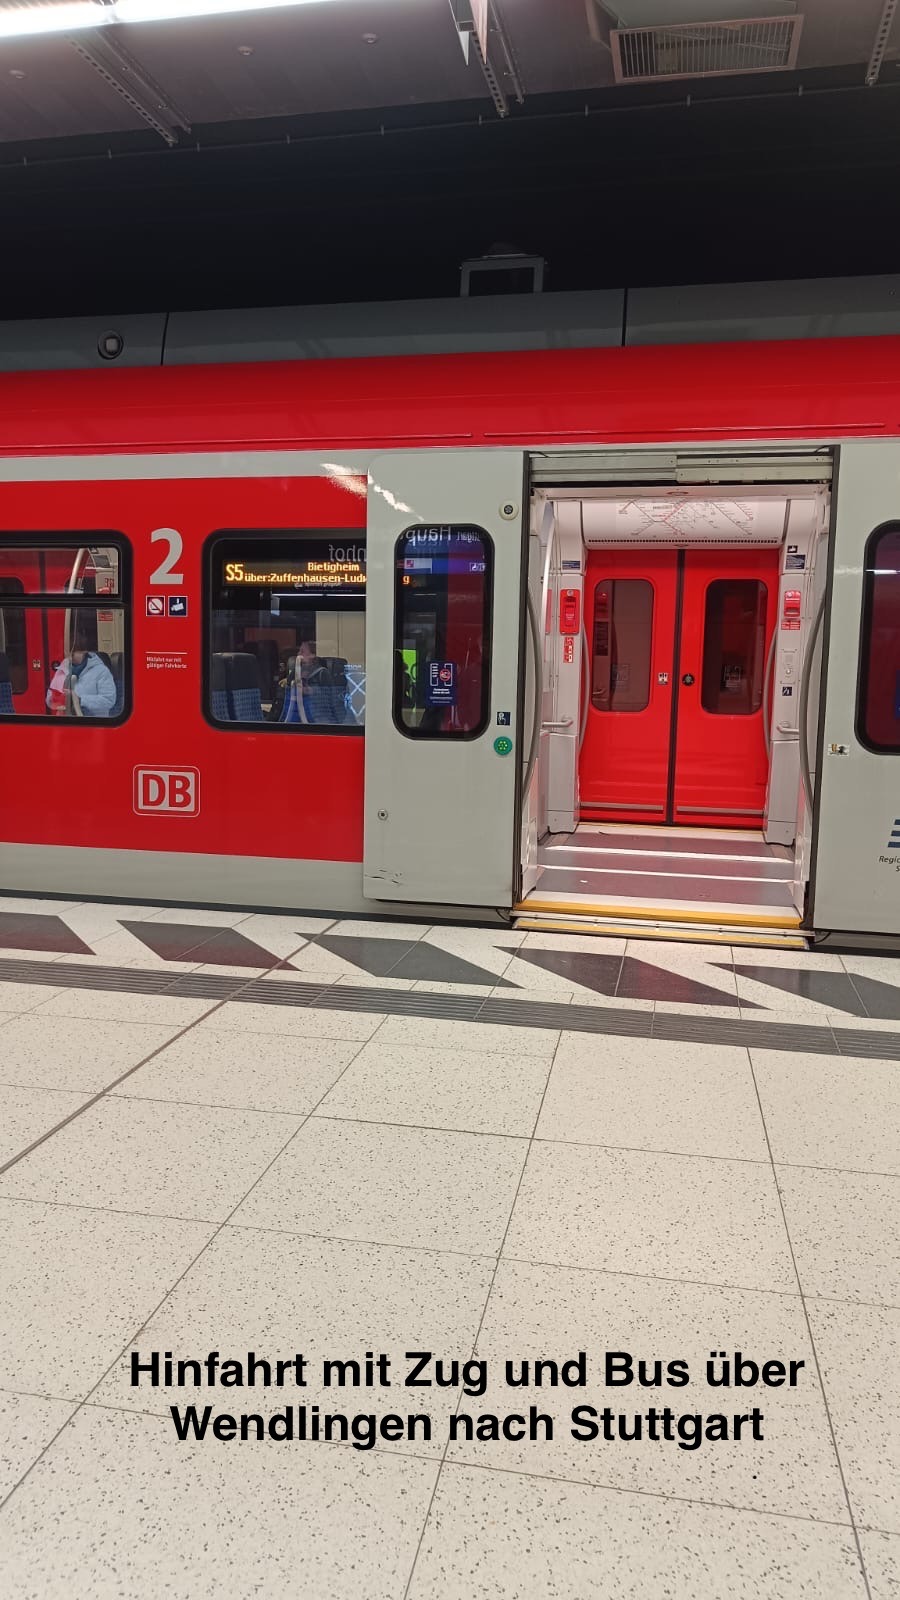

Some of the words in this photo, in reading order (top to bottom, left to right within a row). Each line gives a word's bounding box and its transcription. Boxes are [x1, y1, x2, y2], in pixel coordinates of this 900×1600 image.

[149, 527, 184, 585] 2
[307, 562, 360, 573] Bietigheim
[225, 563, 244, 582] S5
[140, 772, 194, 810] DB
